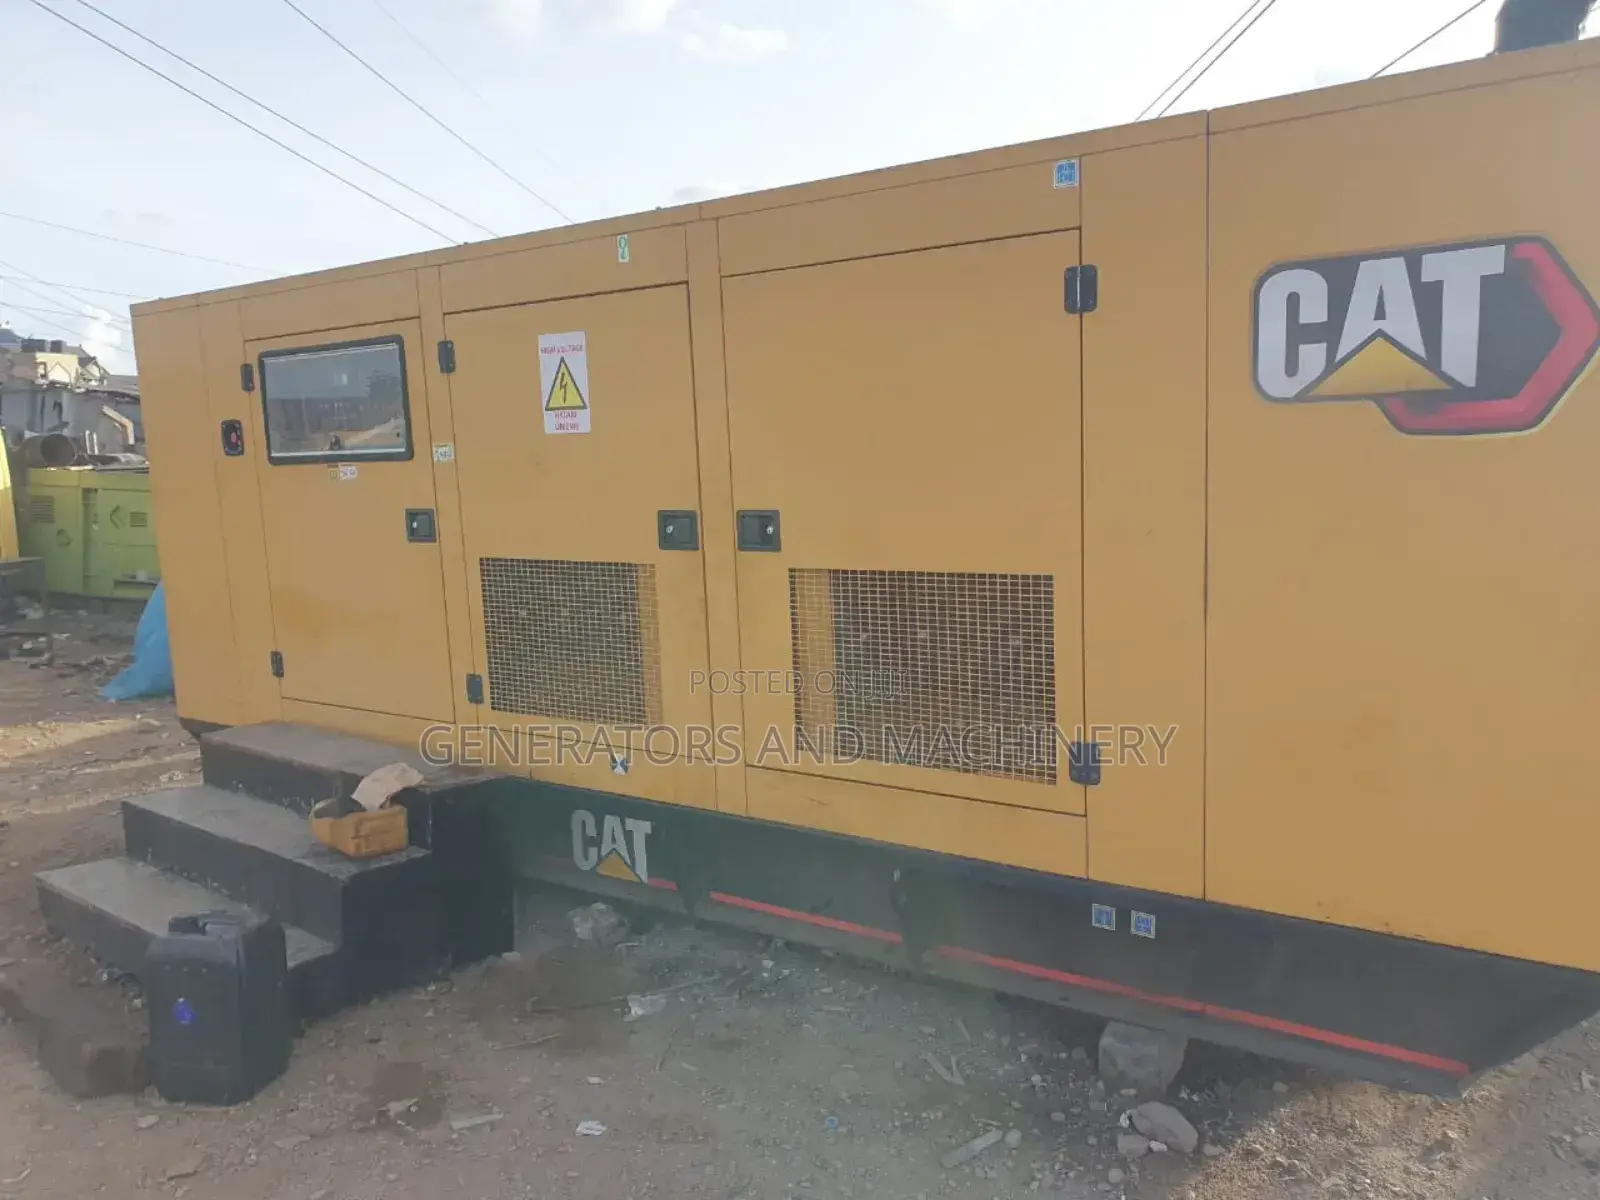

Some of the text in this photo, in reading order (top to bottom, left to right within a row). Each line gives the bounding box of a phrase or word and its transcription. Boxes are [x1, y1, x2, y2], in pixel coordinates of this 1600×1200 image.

[540, 347, 556, 355] HIGH
[1257, 244, 1505, 398] CAT
[571, 809, 652, 884] CAT
